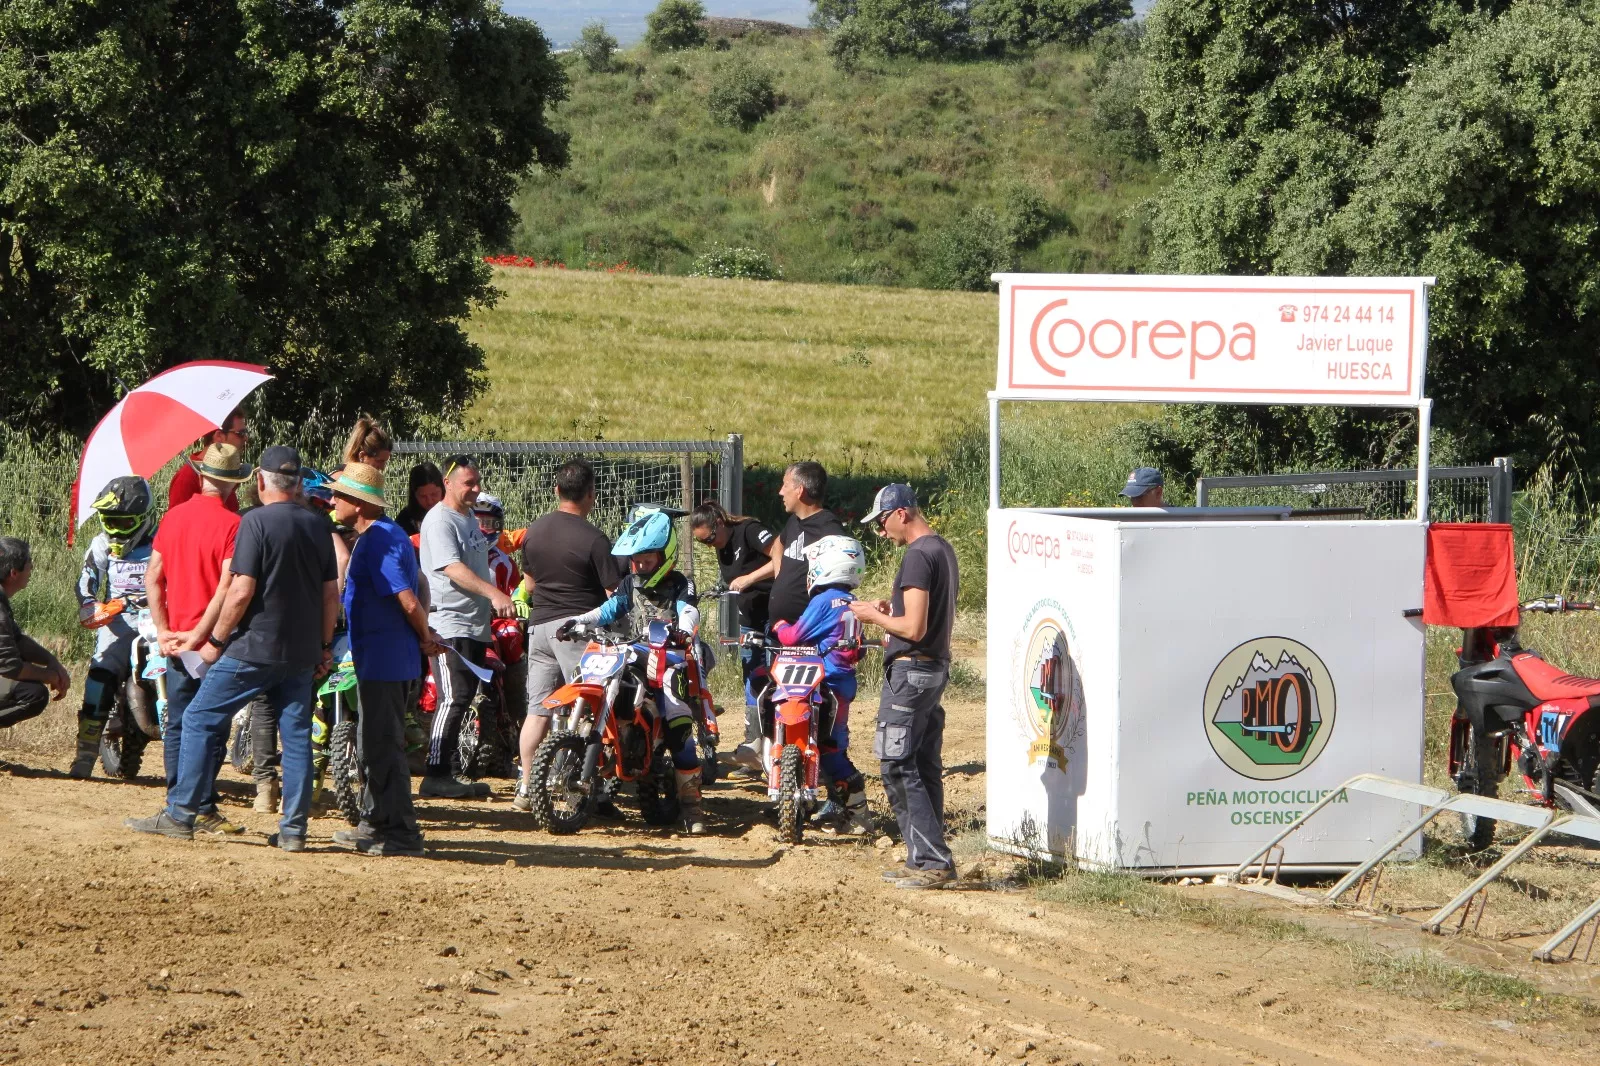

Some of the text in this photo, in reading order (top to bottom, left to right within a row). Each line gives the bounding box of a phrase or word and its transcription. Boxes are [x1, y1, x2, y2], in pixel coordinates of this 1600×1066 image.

[1303, 305, 1395, 323] 974 24 44 14
[1029, 298, 1256, 380] Coorepa
[1296, 333, 1394, 356] Javier Luque
[1327, 361, 1393, 380] HUESCA
[1007, 520, 1060, 568] Coorepa
[781, 664, 819, 685] 111
[1241, 672, 1312, 753] PMO
[1186, 788, 1228, 806] PEÑA
